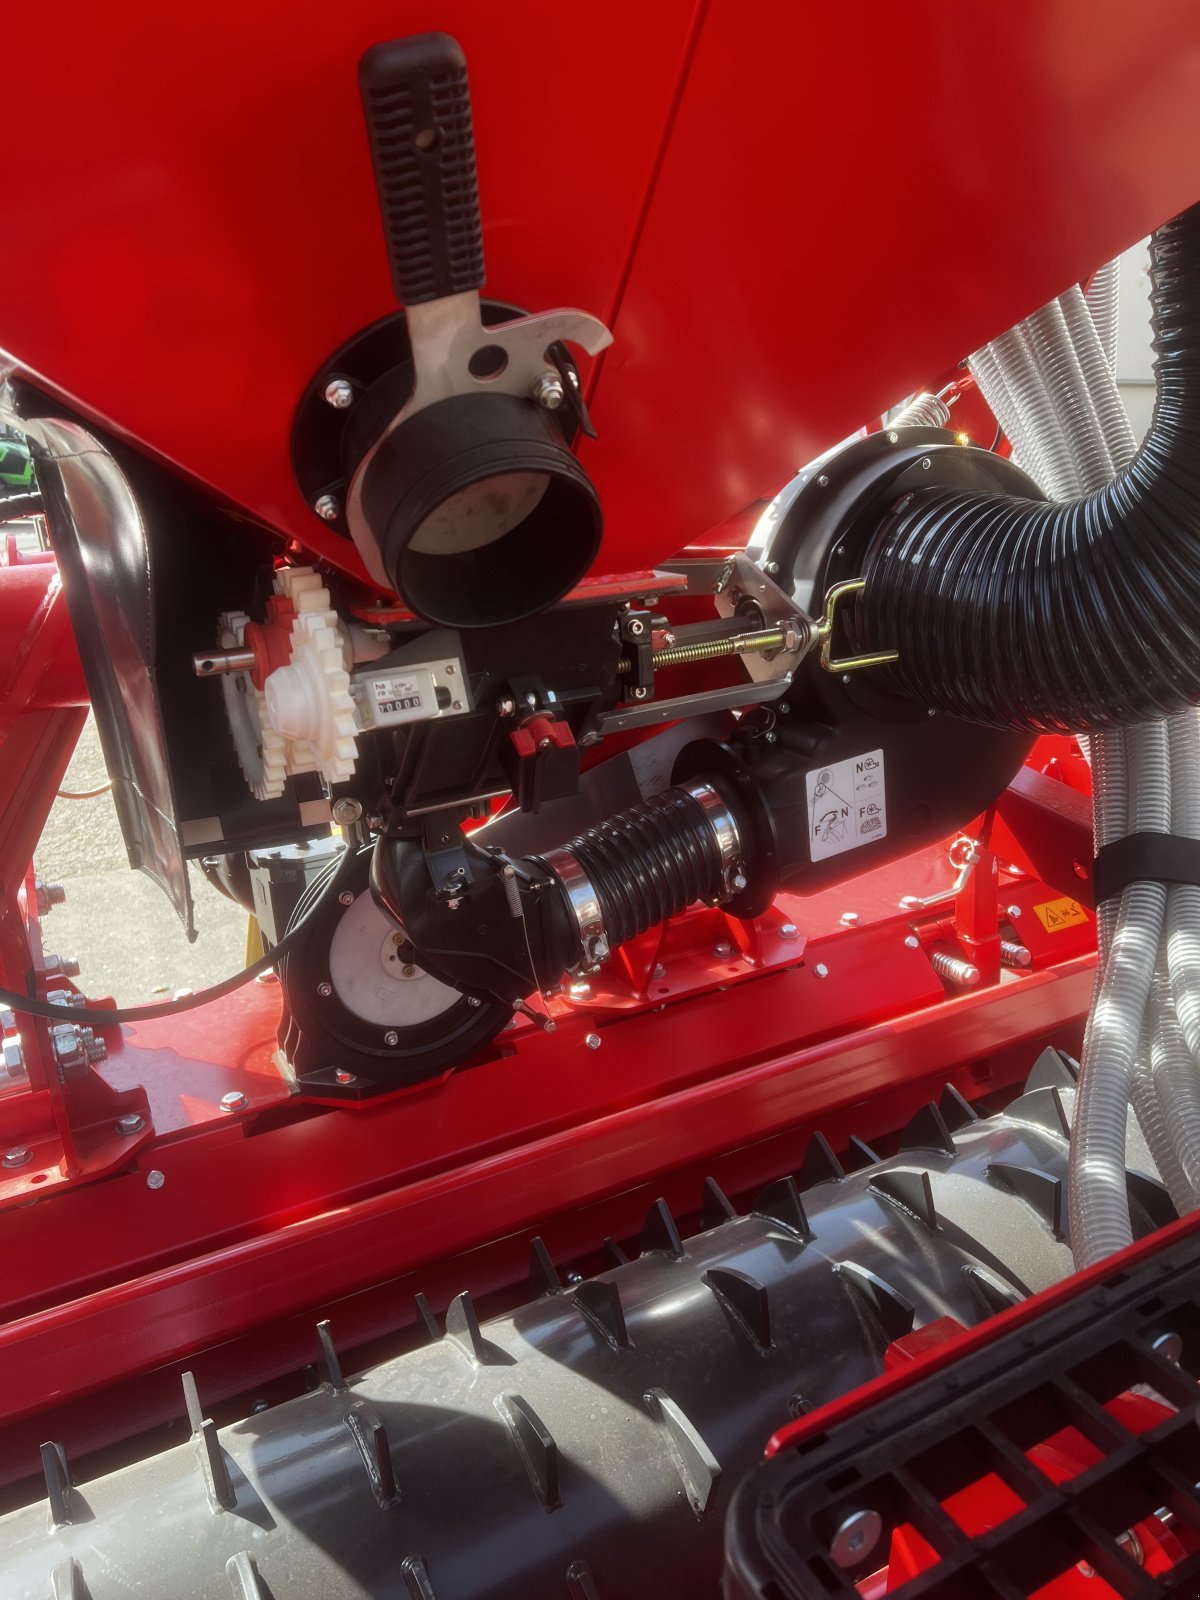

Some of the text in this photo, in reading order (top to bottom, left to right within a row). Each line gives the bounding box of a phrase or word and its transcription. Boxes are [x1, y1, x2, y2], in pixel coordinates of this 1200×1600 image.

[856, 763, 864, 773] N
[841, 807, 849, 818] N
[859, 807, 866, 817] F
[815, 825, 821, 836] F
